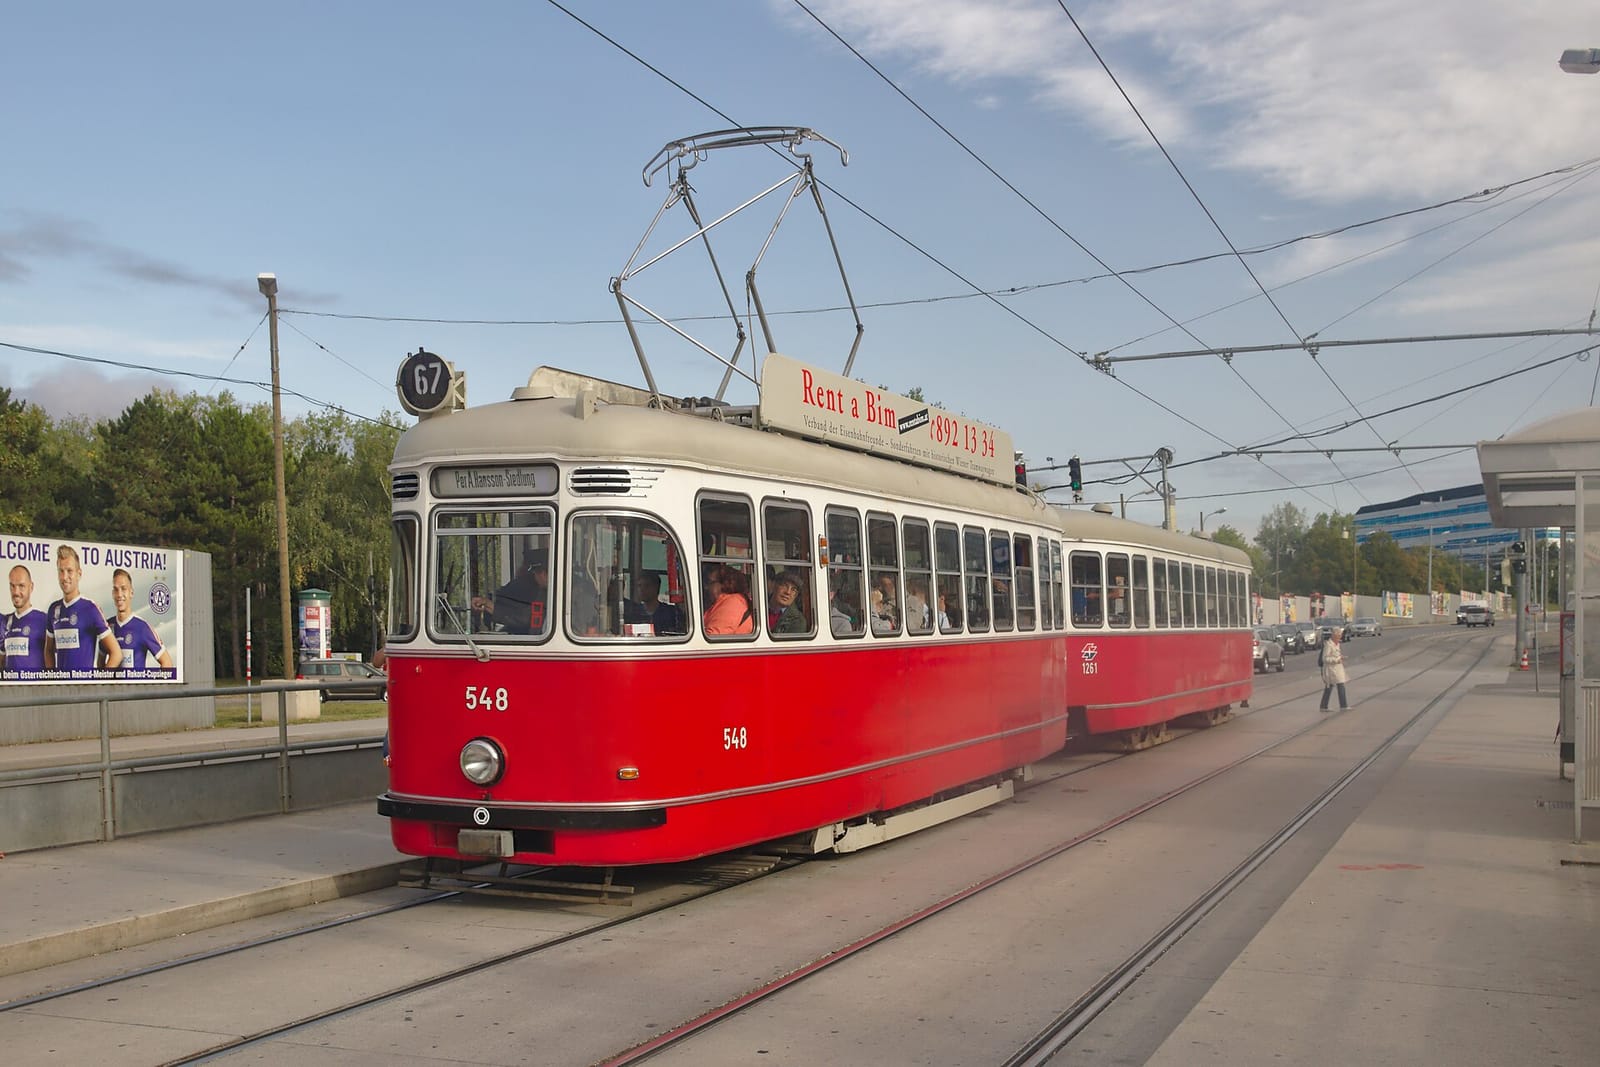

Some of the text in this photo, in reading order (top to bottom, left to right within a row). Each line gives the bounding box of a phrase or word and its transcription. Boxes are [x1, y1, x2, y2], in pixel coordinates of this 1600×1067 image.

[414, 362, 442, 395] 67
[801, 368, 844, 414] Rent
[851, 397, 859, 419] a
[865, 390, 897, 429] Bim
[803, 414, 828, 432] Verband
[829, 420, 838, 436] der
[839, 424, 884, 447] Eisenbahnfreunde
[964, 424, 977, 454] 13
[982, 430, 995, 458] 34
[454, 470, 467, 489] Per
[81, 546, 99, 565] TO
[104, 548, 167, 570] AUSTRIA!
[3, 669, 19, 679] beim
[20, 669, 71, 679] österreichischen
[115, 669, 126, 678] und
[1082, 662, 1098, 675] 1261
[465, 686, 509, 711] 548
[723, 726, 748, 750] 548
